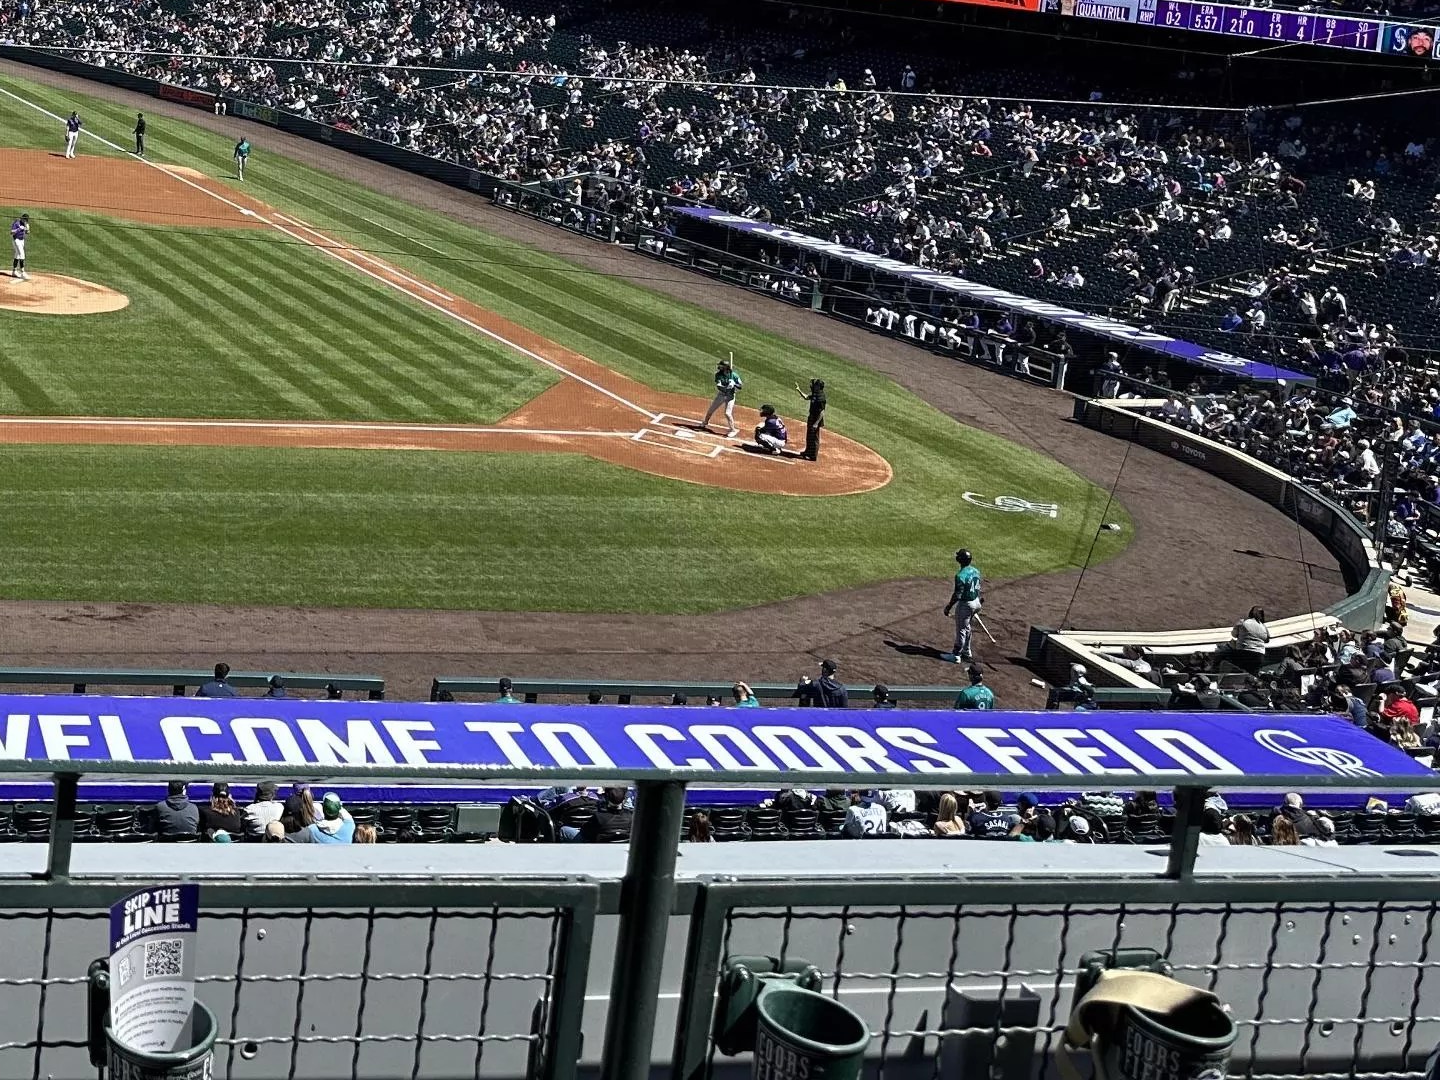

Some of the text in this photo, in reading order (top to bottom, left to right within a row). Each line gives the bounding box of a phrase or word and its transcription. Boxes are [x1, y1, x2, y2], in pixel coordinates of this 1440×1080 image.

[1078, 3, 1127, 21] QUANTRILL
[1168, 1, 1180, 12] W-L
[1201, 5, 1214, 16] ERA
[1140, 10, 1154, 22] RHP
[1165, 12, 1182, 26] 0-2
[1240, 10, 1248, 19] IP
[1271, 13, 1281, 23] ER
[1297, 15, 1307, 26] HR
[1194, 15, 1218, 30] 5.57
[1230, 19, 1254, 35] 21.0
[1325, 19, 1336, 29] BB
[1358, 23, 1369, 32] SO
[1269, 23, 1282, 38] 13
[1296, 26, 1304, 40] 4
[1326, 29, 1334, 44] 7
[1355, 32, 1369, 48] 11
[1181, 444, 1206, 461] TOYOTA
[464, 720, 618, 769] TO
[624, 722, 958, 774] COORS
[957, 726, 1246, 776] FIELD
[863, 819, 884, 834] 24
[984, 819, 1009, 830] SASAKI
[124, 888, 180, 915] SKIP THE
[123, 903, 180, 936] LINE
[760, 1031, 809, 1079] COORS
[1125, 1025, 1181, 1072] COORS
